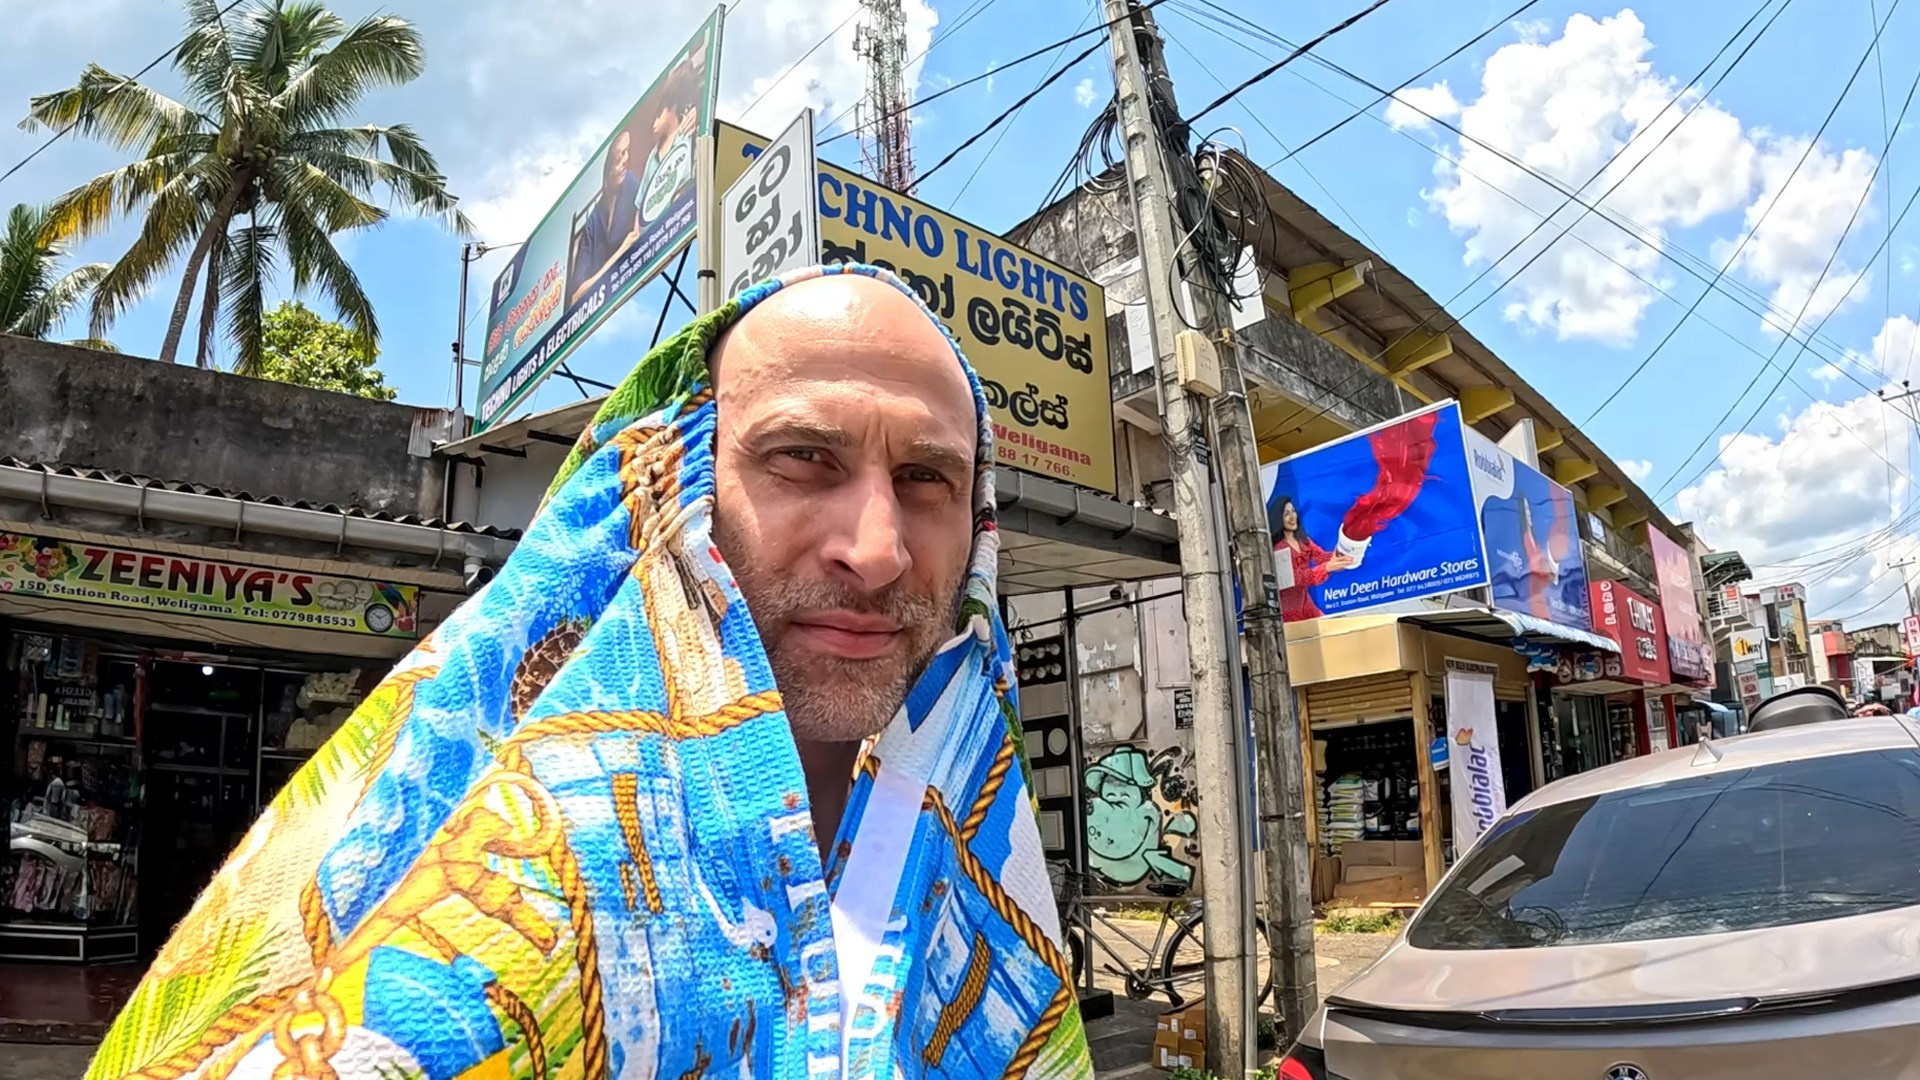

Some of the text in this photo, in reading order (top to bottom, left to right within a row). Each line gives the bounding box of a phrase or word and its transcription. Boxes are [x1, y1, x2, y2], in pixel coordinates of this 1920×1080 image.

[953, 228, 1089, 322] LIGHTS
[481, 376, 512, 424] TECHNO
[512, 353, 538, 393] LIGHTS
[546, 284, 607, 360] ELECTRICALS
[52, 583, 106, 599] Station
[110, 591, 155, 607] Road,
[243, 606, 269, 618] Tel:
[272, 610, 357, 627] 0779845533
[78, 547, 314, 606] ZEENIYA'S
[1324, 557, 1479, 601] New Deen Hardware Stores
[1466, 742, 1495, 838] obbialac
